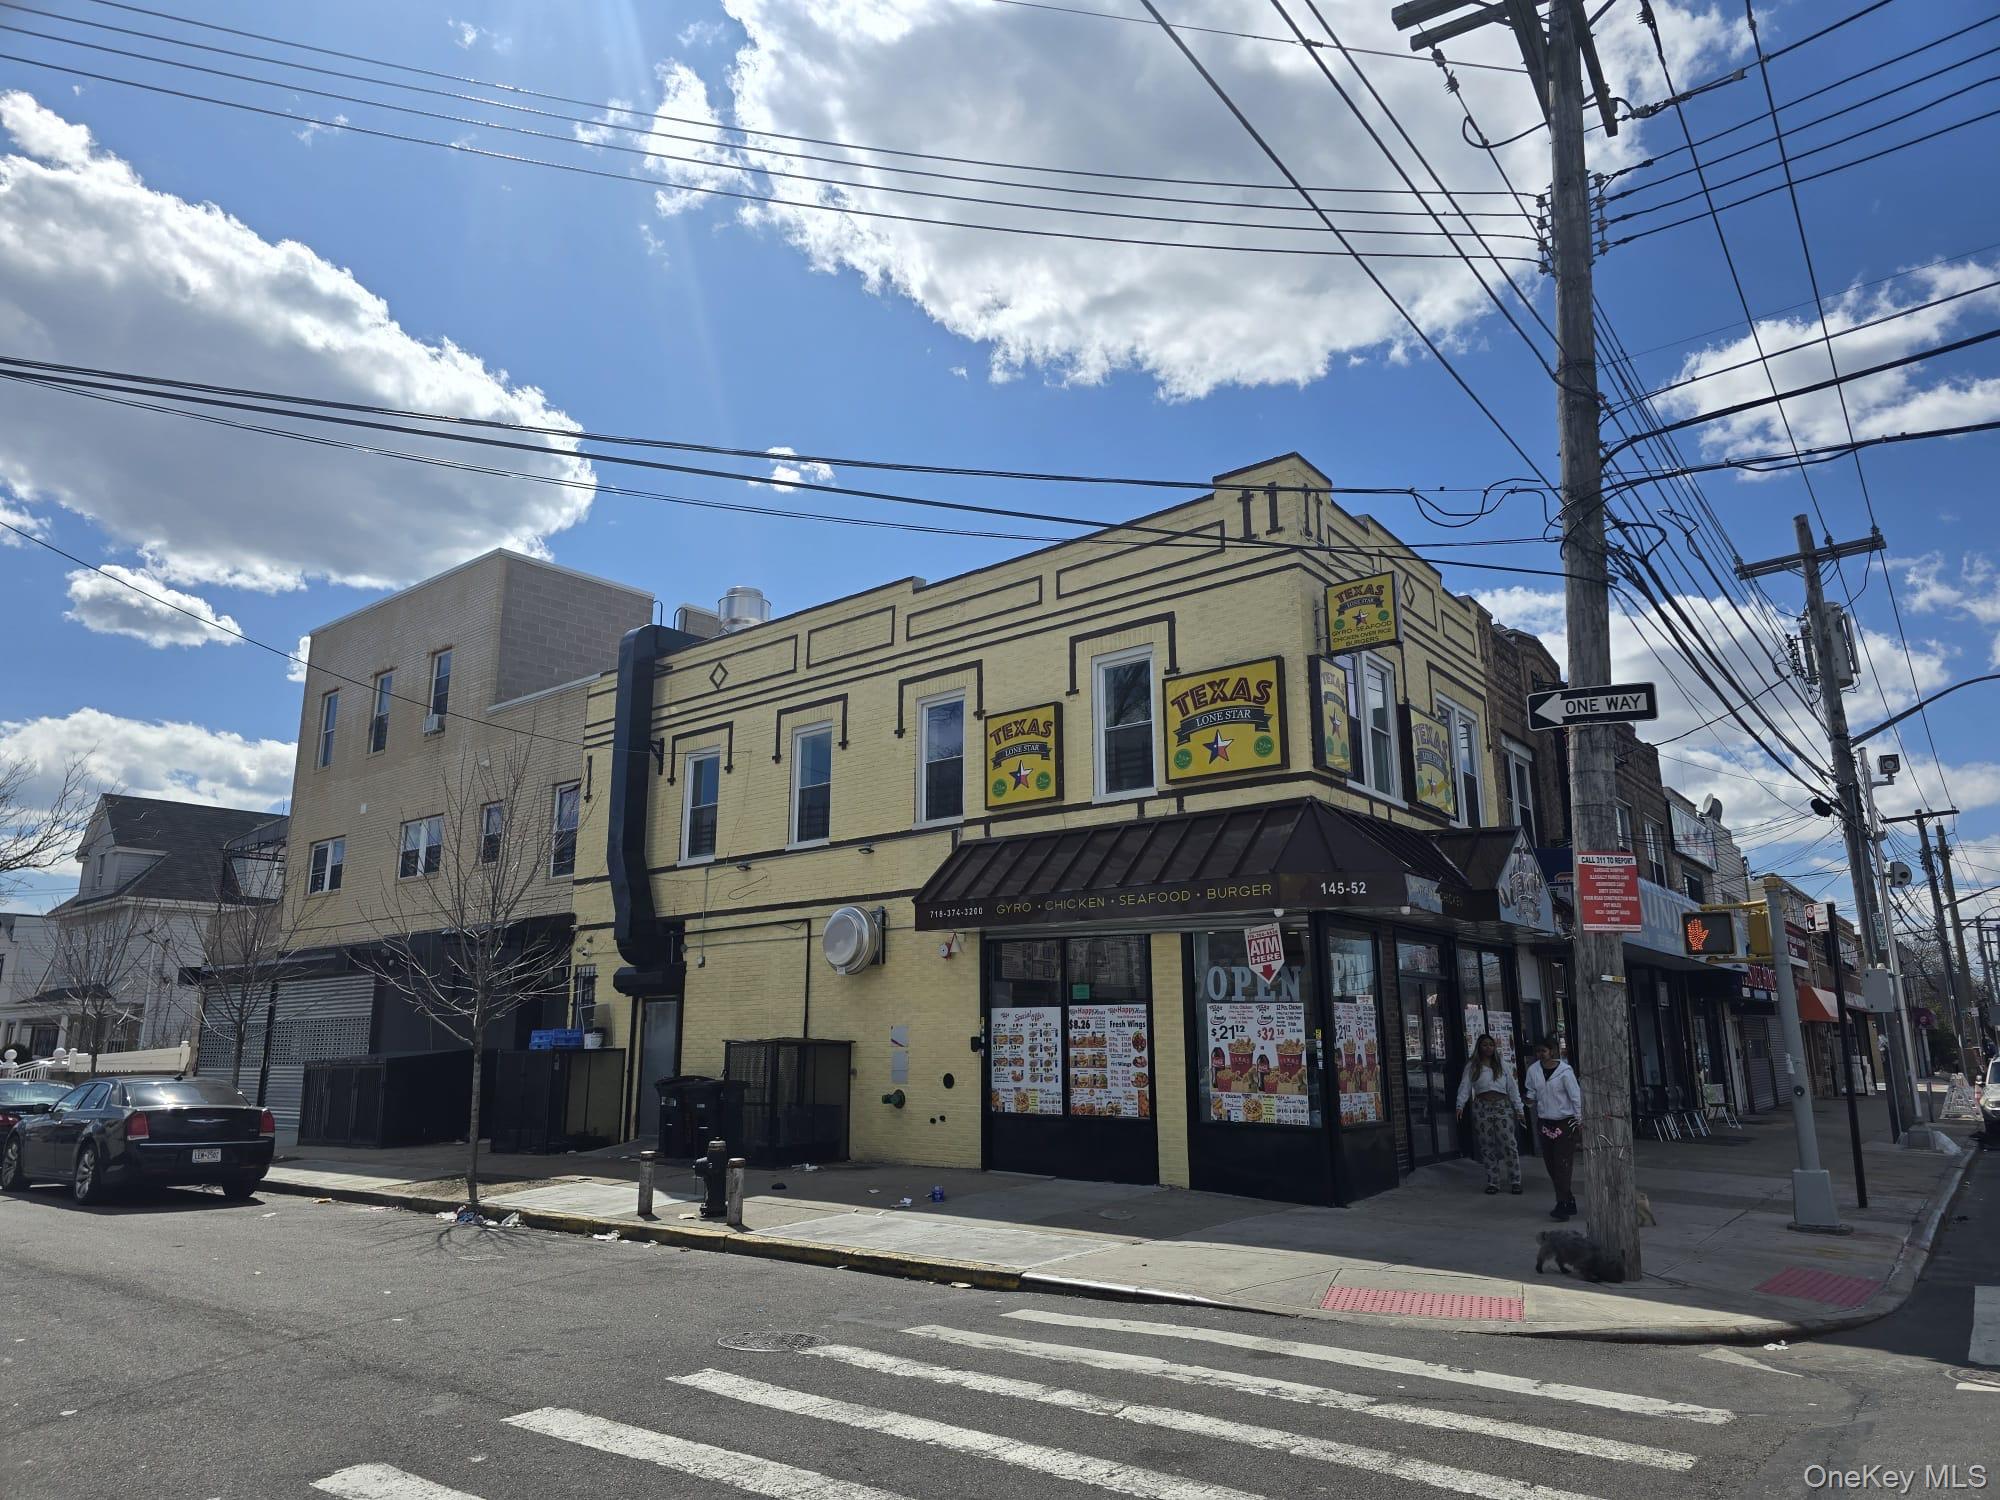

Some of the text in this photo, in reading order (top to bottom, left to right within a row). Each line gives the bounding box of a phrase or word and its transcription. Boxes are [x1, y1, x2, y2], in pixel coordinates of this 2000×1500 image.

[1334, 584, 1384, 602] TEXAS
[1332, 621, 1392, 637] GYRO SEAFOOD
[1333, 634, 1359, 643] CHICKEN
[1346, 636, 1379, 646] BURGERS
[1170, 677, 1273, 717] TEXAS
[1565, 695, 1641, 714] ONE WAY
[1196, 709, 1251, 727] LONE STAR
[990, 718, 1053, 745] TEXAS
[1413, 723, 1448, 760] TEXAS
[1005, 744, 1040, 756] LONE STAR
[1320, 881, 1367, 895] 145-52
[996, 884, 1272, 915] GYRO CHICKEN SEAFOOD BURGER
[929, 907, 983, 918] 718-374-3200
[1250, 936, 1280, 957] ATM
[1251, 952, 1281, 964] HERE
[1207, 965, 1301, 1001] OPEN
[1014, 1010, 1032, 1020] Special
[1077, 1008, 1095, 1016] Happy
[1117, 1006, 1135, 1015] Happy
[1069, 1019, 1090, 1029] $8.26
[1109, 1020, 1126, 1028] Fresh
[1127, 1020, 1146, 1029] Wings
